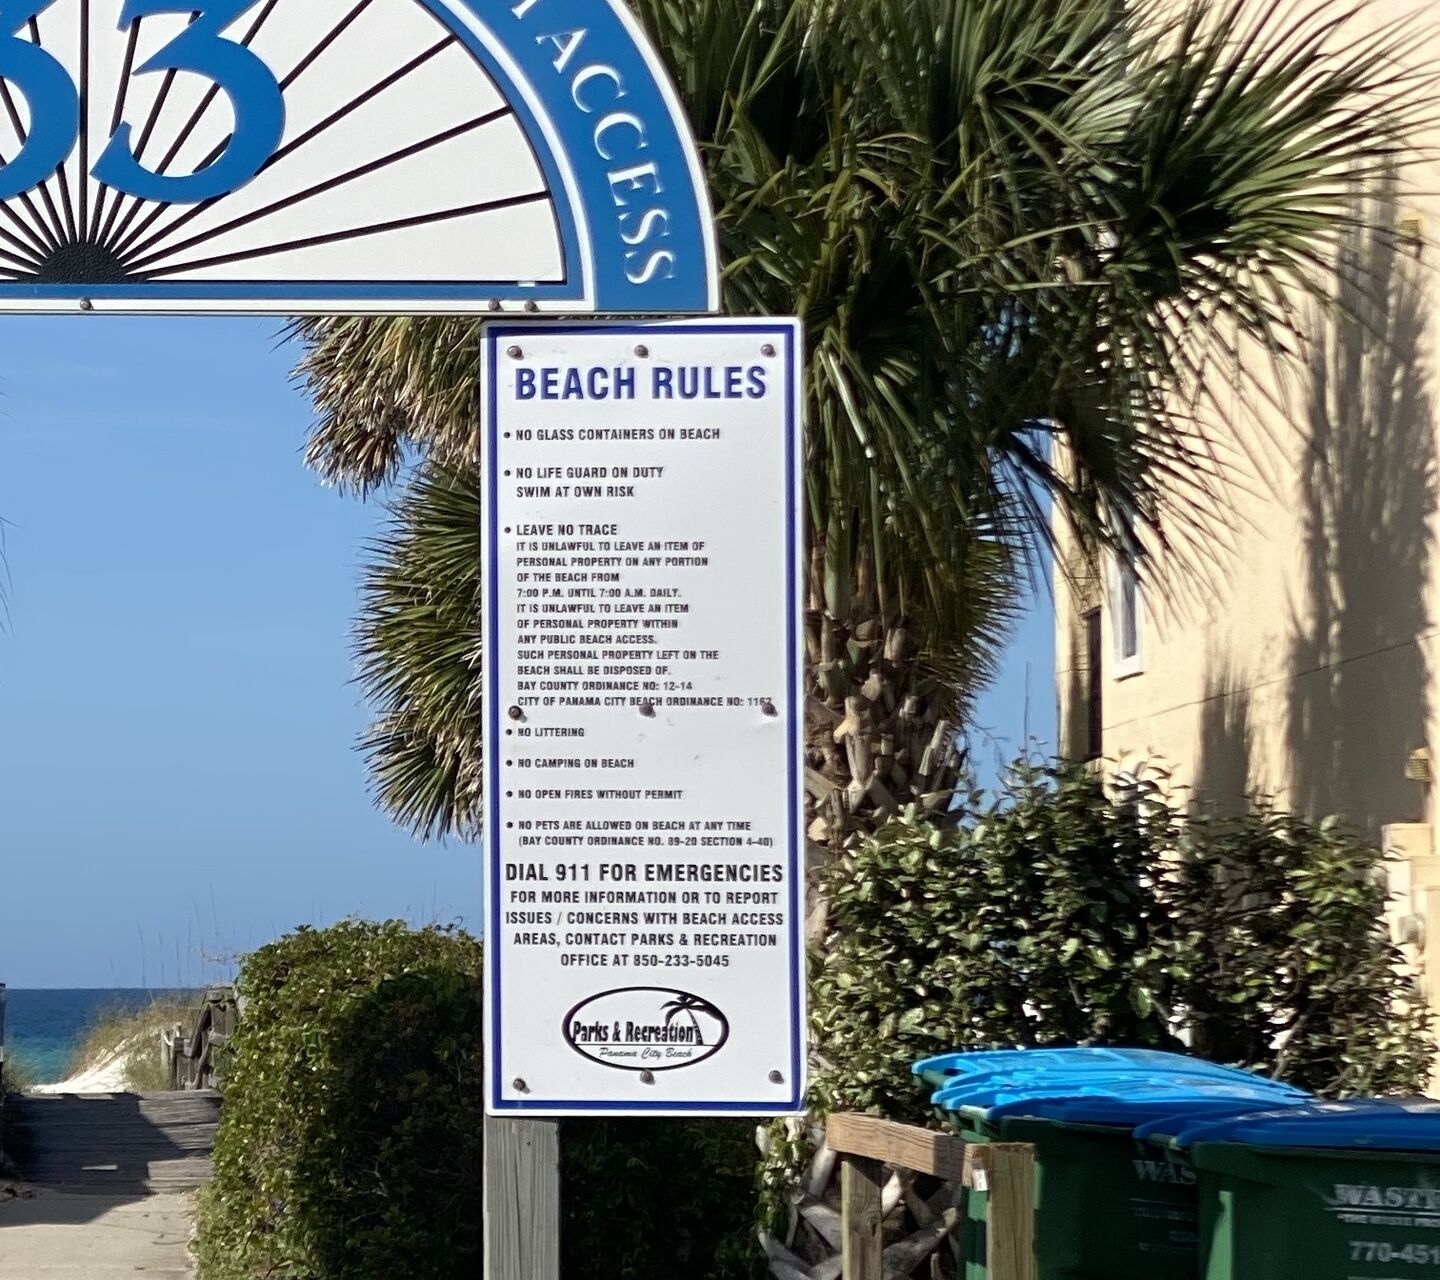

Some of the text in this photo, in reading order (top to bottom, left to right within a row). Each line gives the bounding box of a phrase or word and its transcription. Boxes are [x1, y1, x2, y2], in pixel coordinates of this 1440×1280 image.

[536, 27, 676, 286] ACCESS
[516, 365, 766, 400] BEACH RULES
[516, 428, 720, 441] NO GLASS CONTAINERS ON BEACH
[516, 466, 664, 479] NO LIFE GUARD ON DUTY
[516, 485, 634, 498] SWIM AT OWN RISK
[516, 524, 617, 536] LEAVE NO TRACE
[517, 727, 585, 737] NO LITTERING
[505, 863, 783, 882] DIAL 911 FOR EMERGENCIES
[510, 890, 779, 904] FOR MORE INFORMATION OR TO REPORT
[506, 911, 552, 924] ISSUES
[567, 911, 639, 925] CONCERNS
[643, 912, 677, 925] WITH
[682, 912, 727, 925] BEACH
[731, 912, 783, 926] ACCESS
[513, 932, 777, 947] AREAS, CONTACT PARKS & RECREATION
[560, 953, 729, 967] OFFICE AT 850-233-5045
[573, 1021, 694, 1043] Parks & Recreation
[599, 1046, 692, 1061] Panama City Beach
